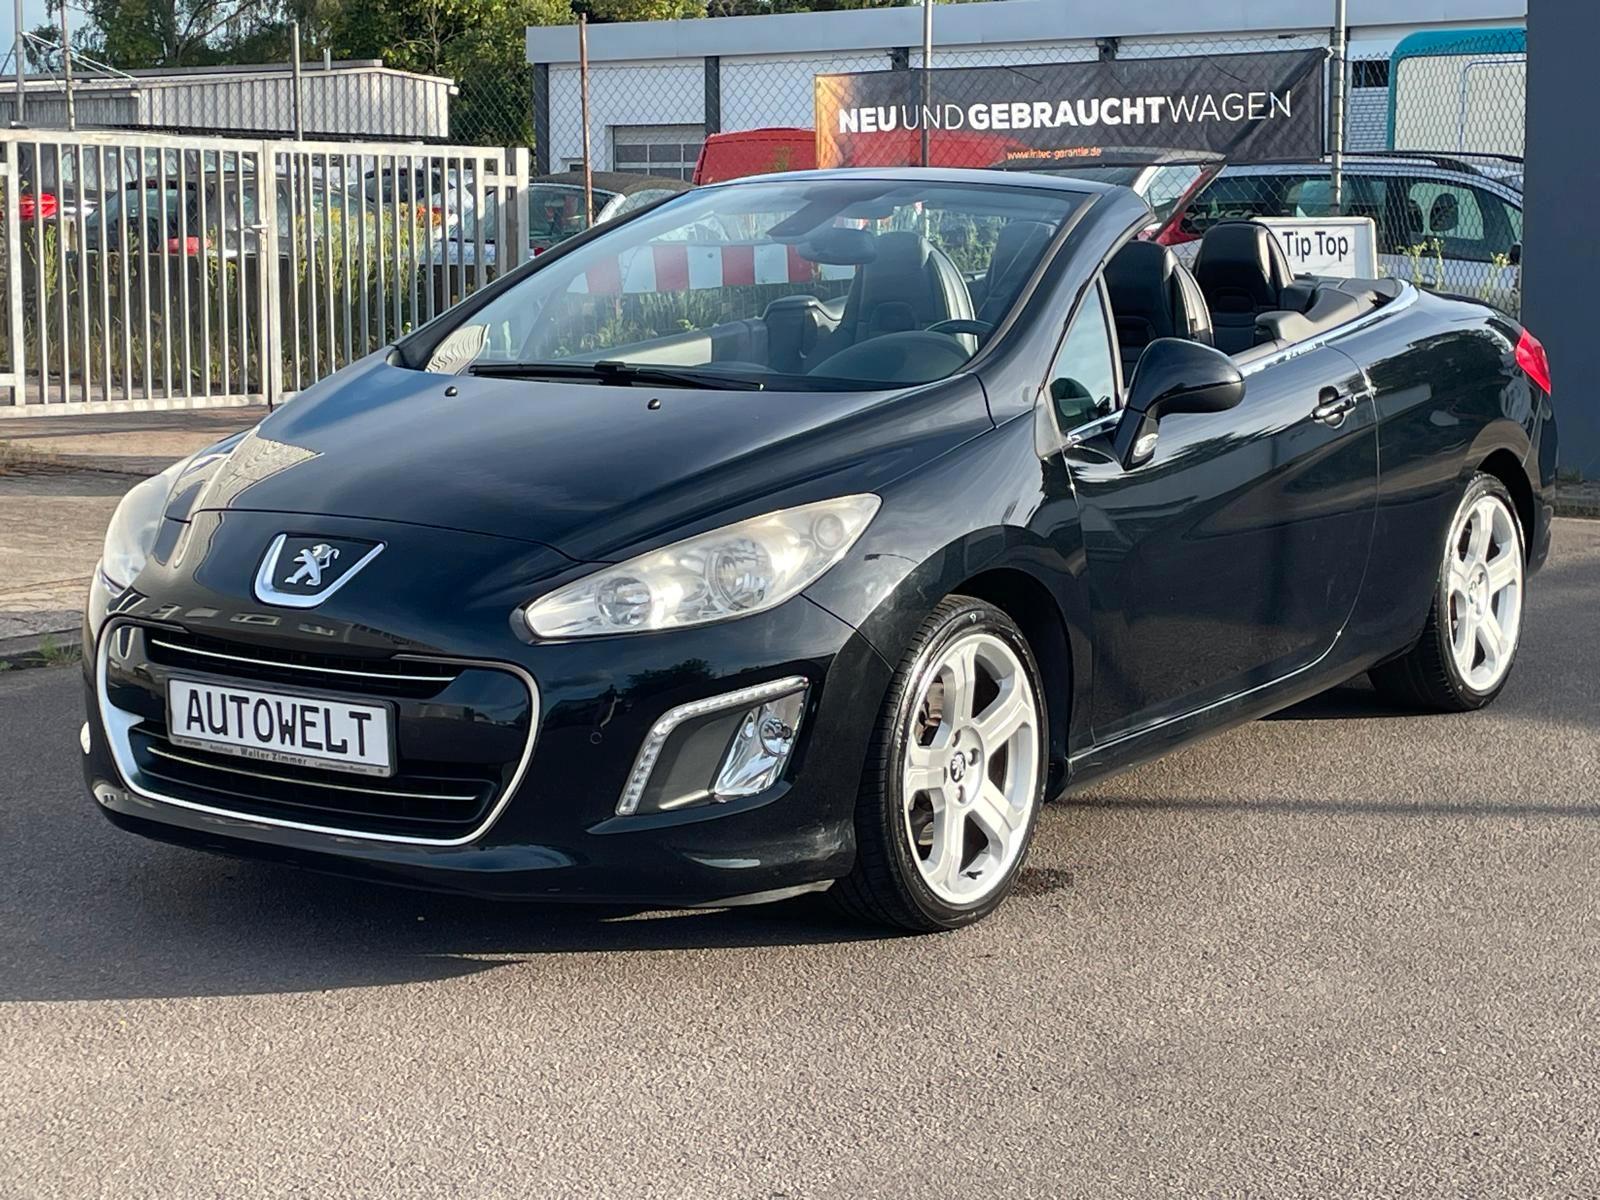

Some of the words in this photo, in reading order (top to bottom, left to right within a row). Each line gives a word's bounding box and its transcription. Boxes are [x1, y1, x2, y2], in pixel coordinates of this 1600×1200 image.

[1282, 231, 1312, 262] Tip
[1315, 231, 1348, 262] Top
[186, 688, 372, 757] AUTOWELT
[240, 749, 270, 761] Walter
[272, 752, 307, 766] Zimmer
